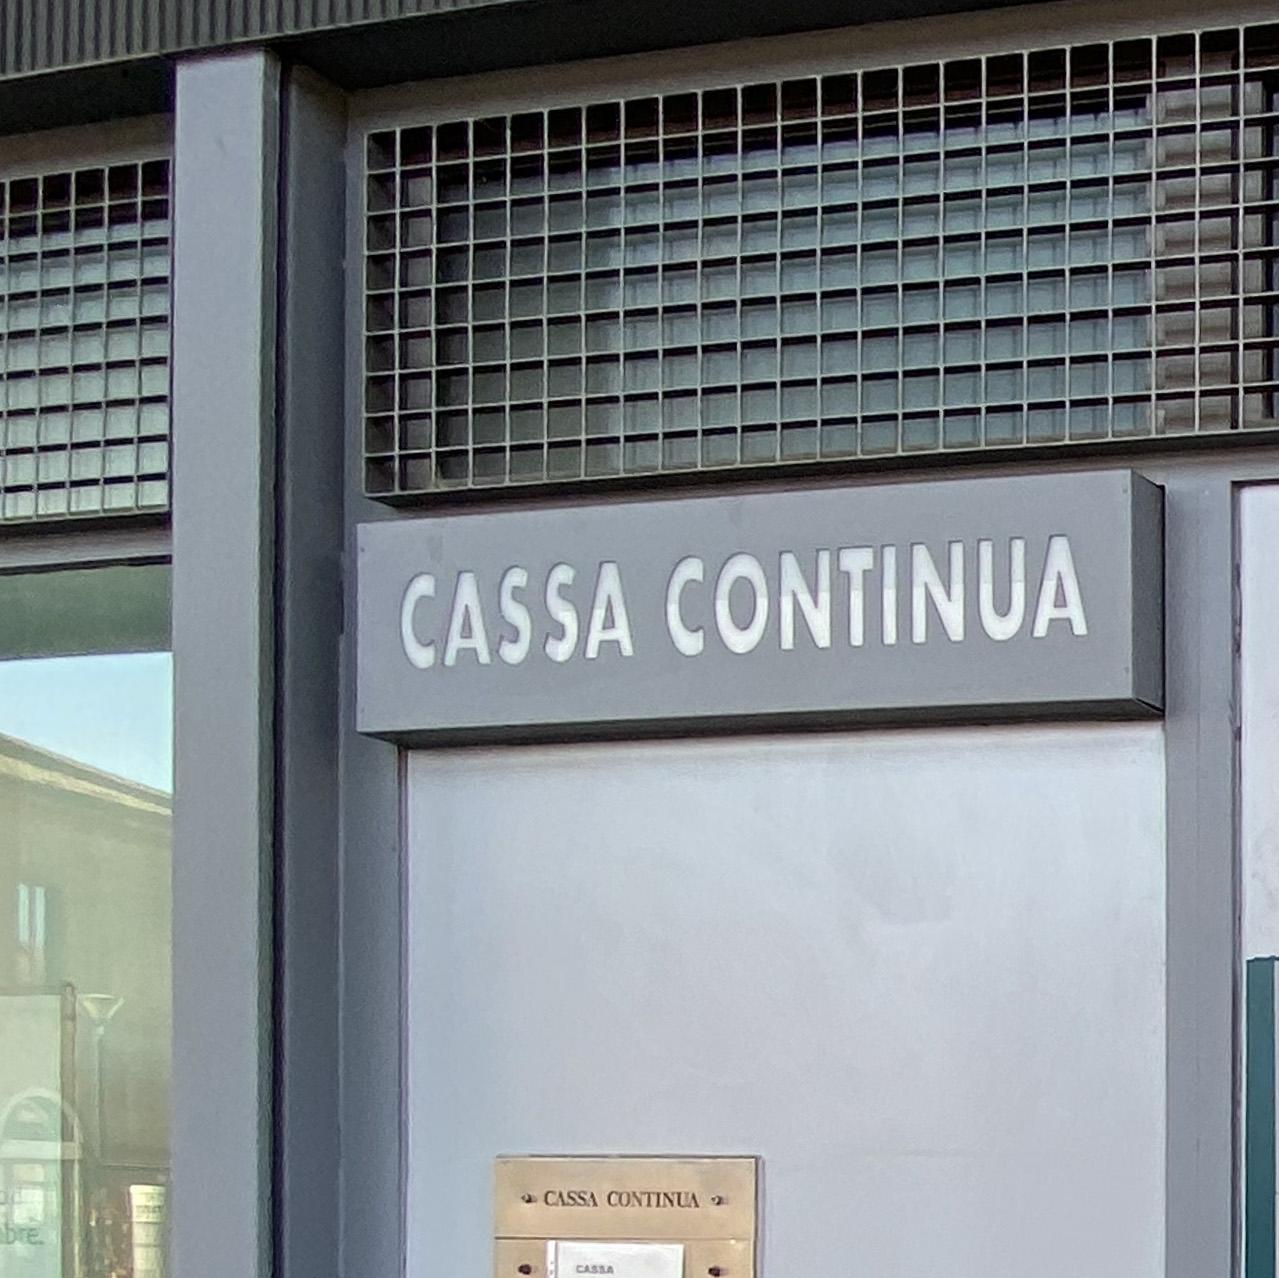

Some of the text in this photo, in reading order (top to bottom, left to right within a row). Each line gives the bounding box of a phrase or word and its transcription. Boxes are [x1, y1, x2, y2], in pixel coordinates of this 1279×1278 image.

[400, 533, 1089, 670] CASSA CONTINUA
[544, 1190, 700, 1208] CASSA CONTINUA
[576, 1264, 615, 1275] CASSA
